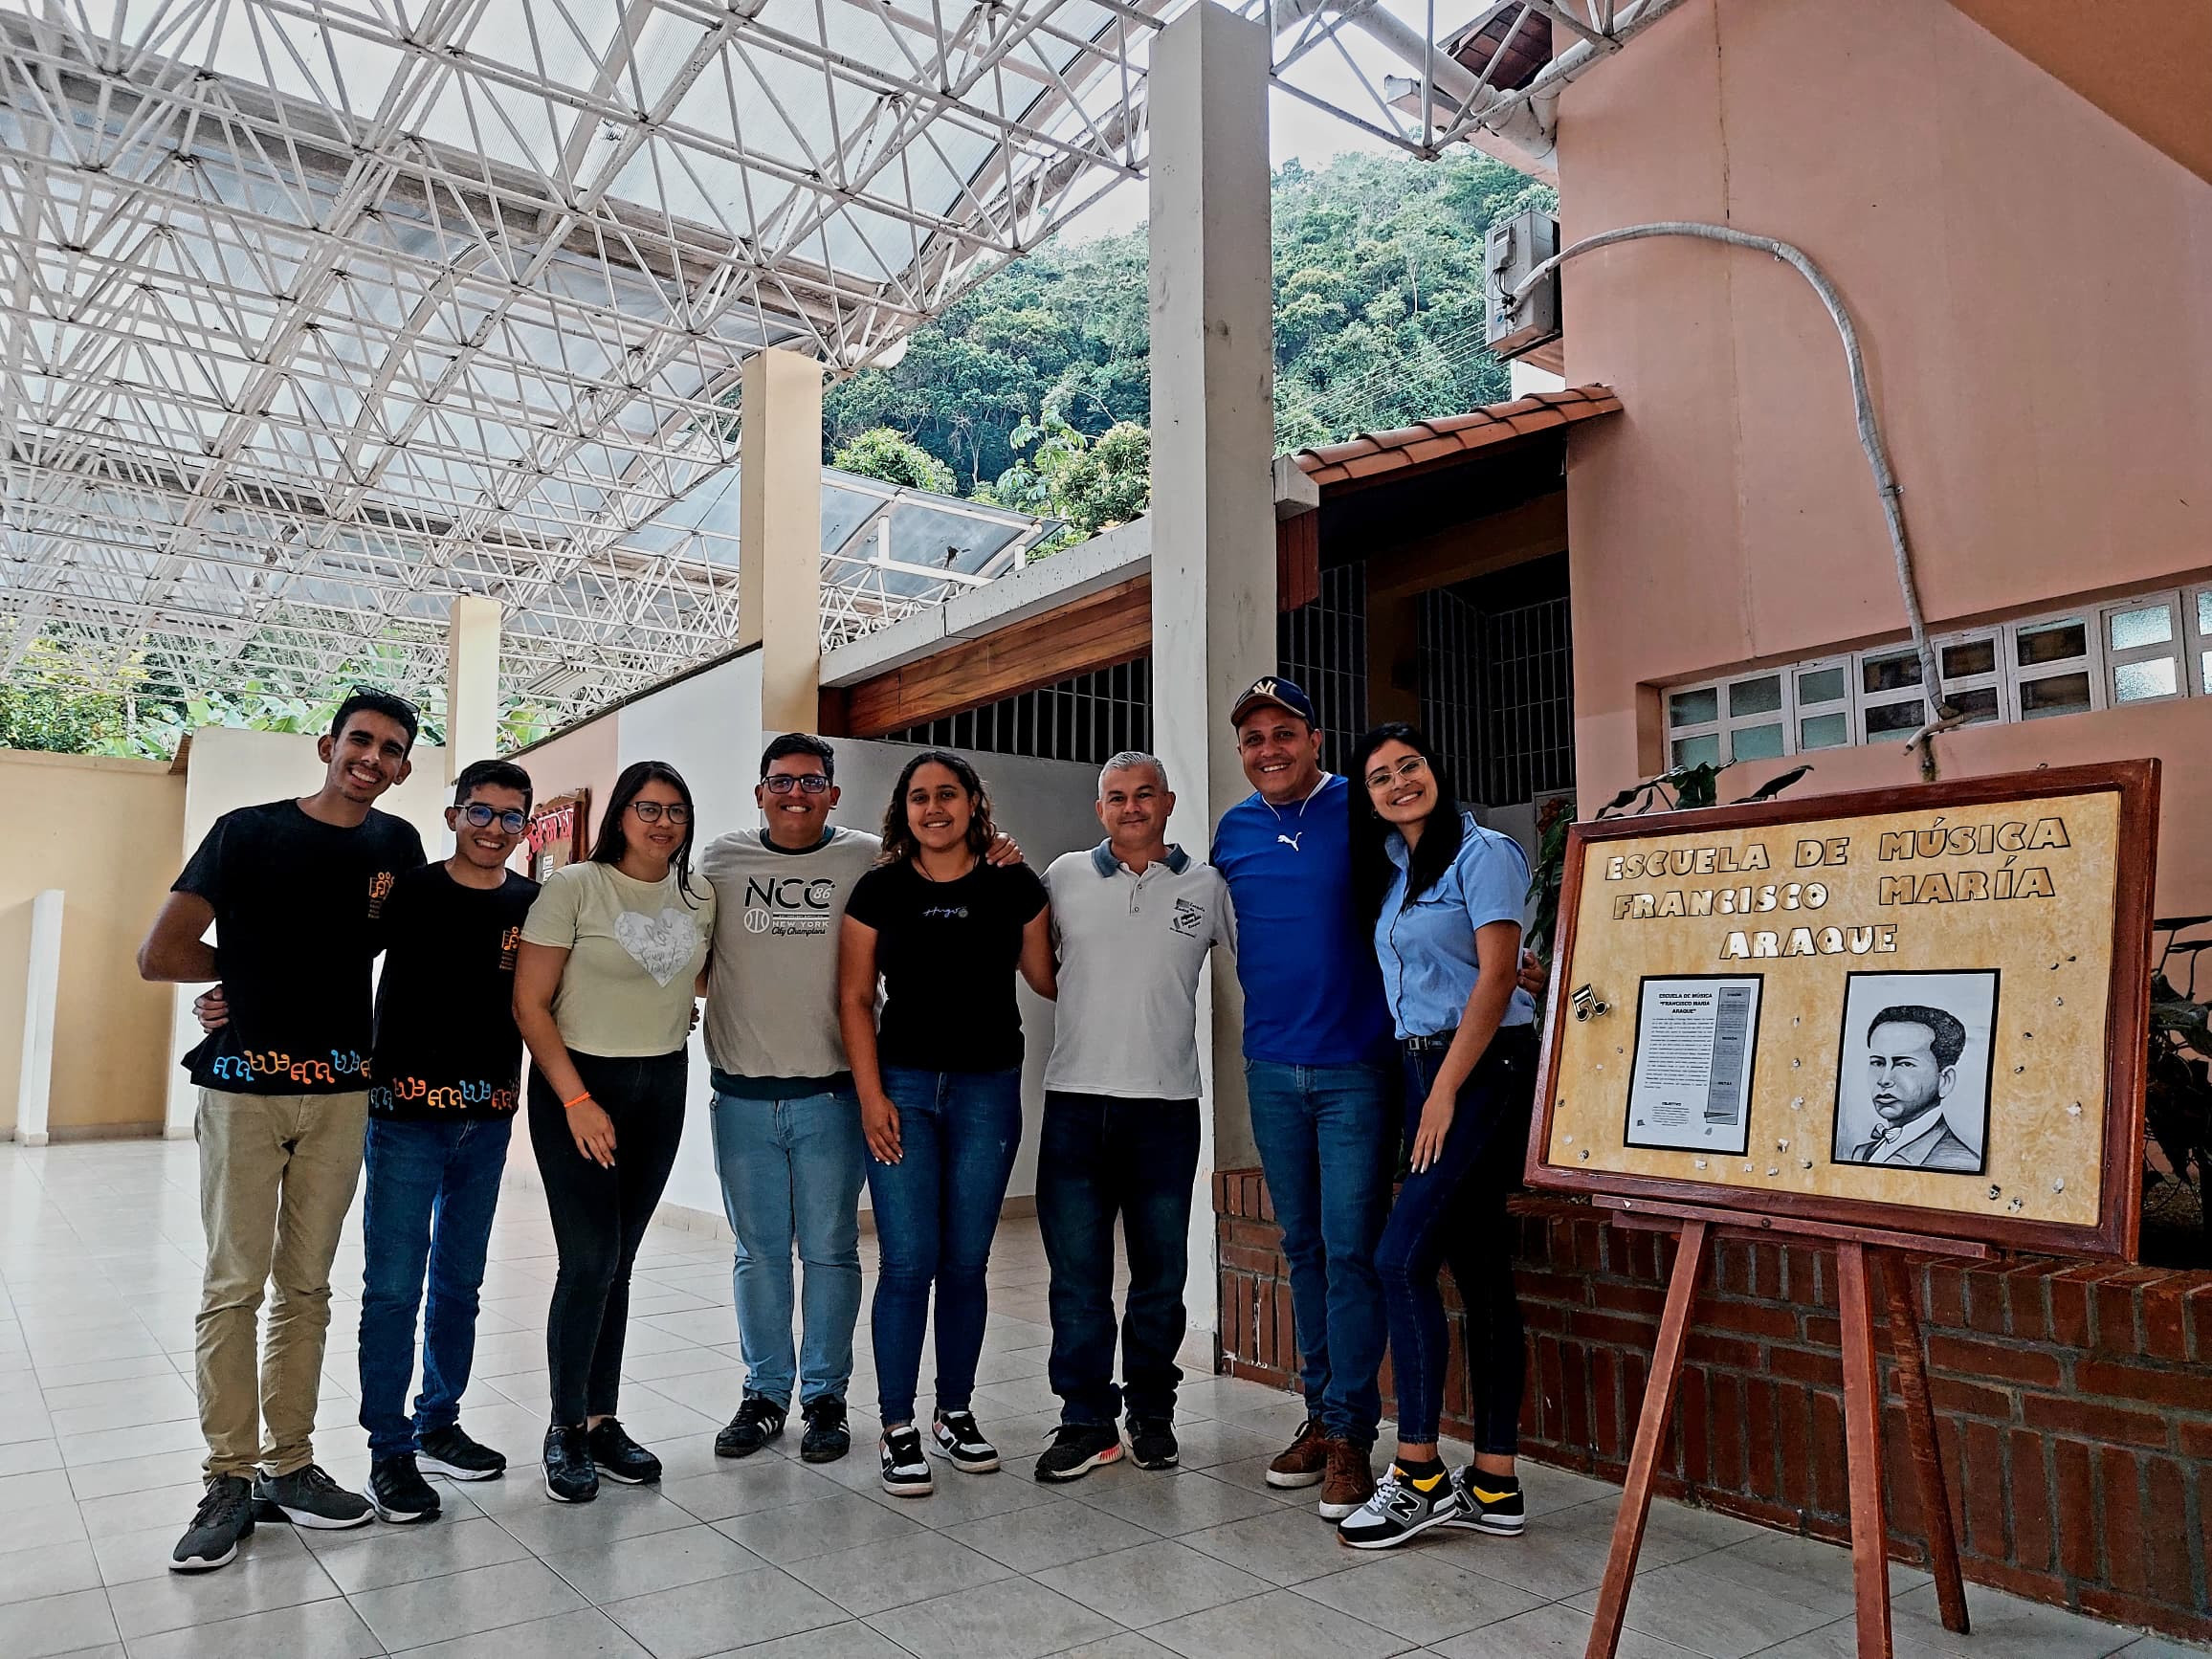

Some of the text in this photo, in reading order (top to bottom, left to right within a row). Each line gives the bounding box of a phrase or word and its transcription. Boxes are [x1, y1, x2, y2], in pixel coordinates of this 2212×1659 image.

[1605, 816, 2071, 880] ESCUELA DE MÚSICA
[744, 876, 832, 909] NCC
[813, 887, 831, 899] 86
[1613, 855, 2056, 919] FRANCISCO MARÍA
[1719, 923, 1898, 960] ARAQUE
